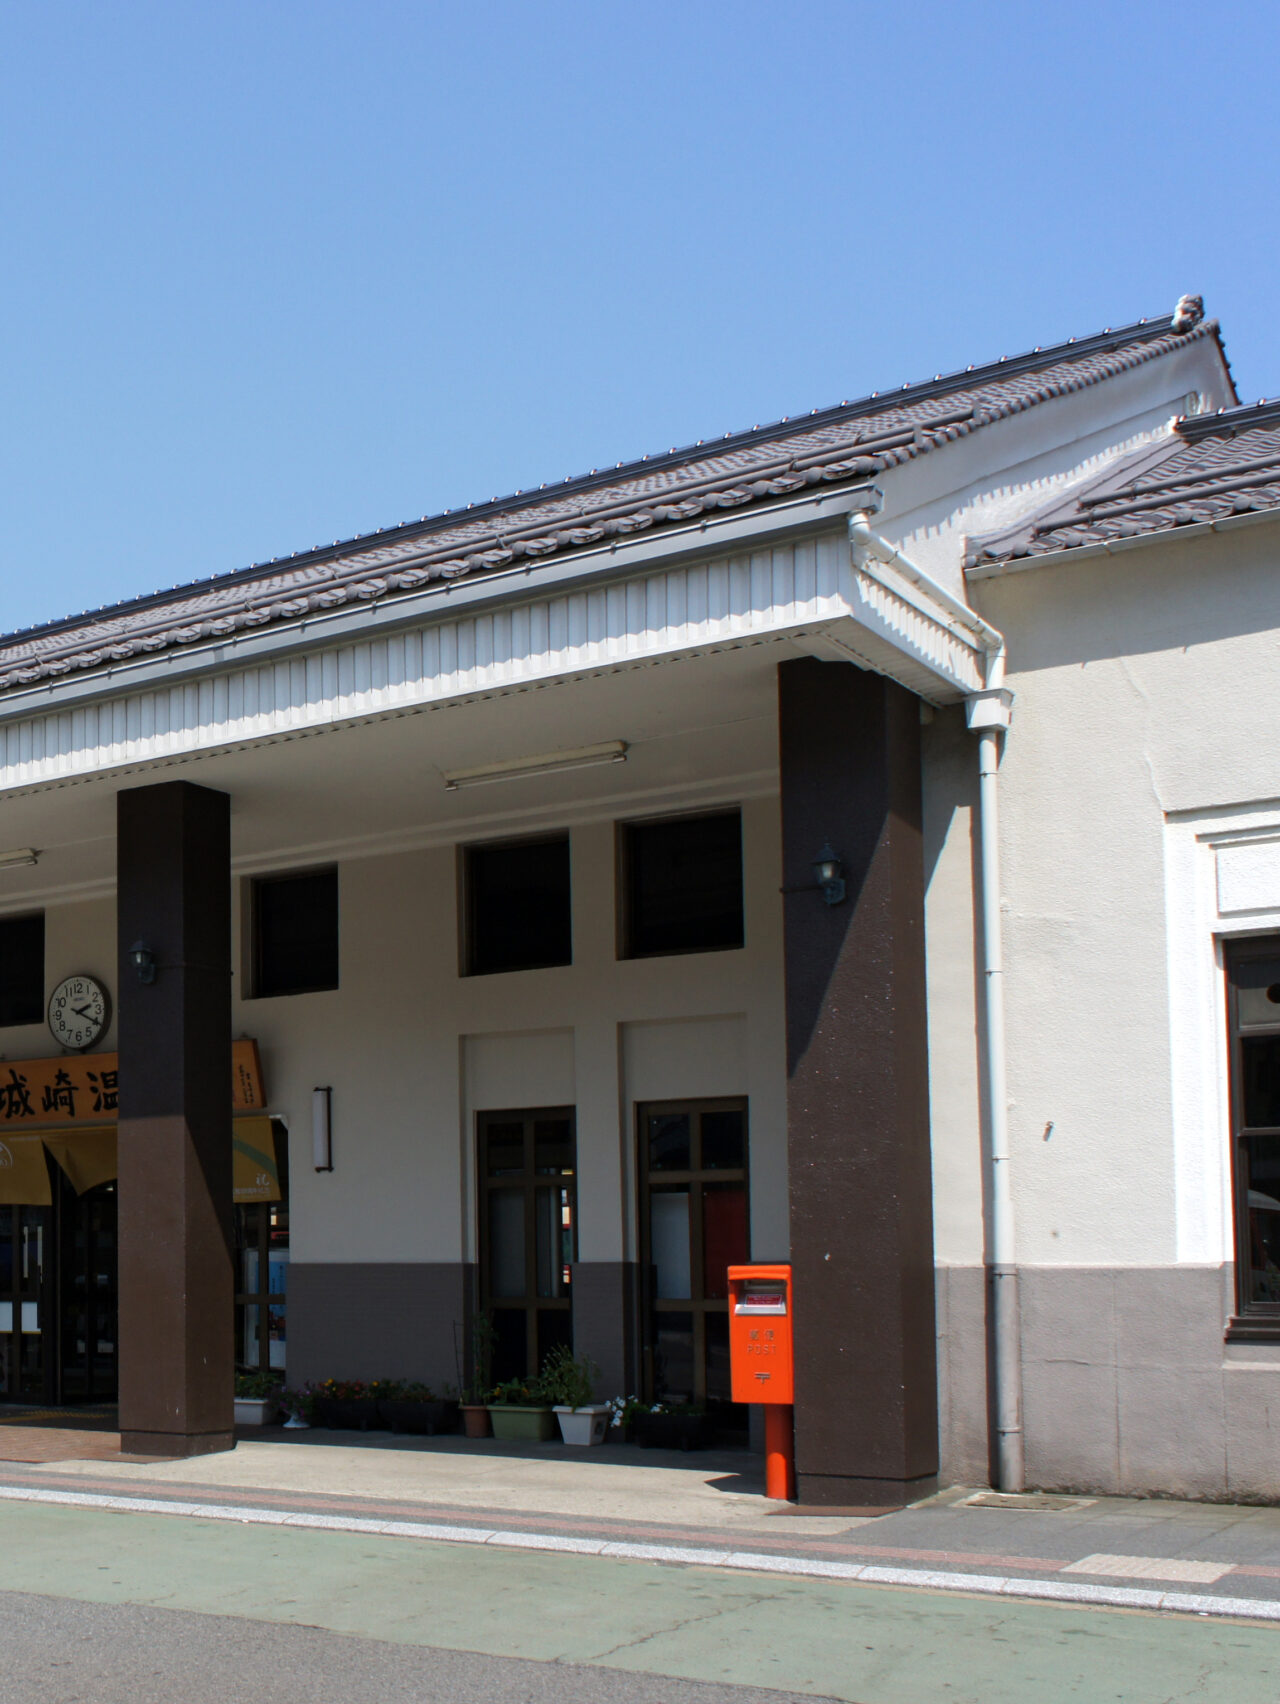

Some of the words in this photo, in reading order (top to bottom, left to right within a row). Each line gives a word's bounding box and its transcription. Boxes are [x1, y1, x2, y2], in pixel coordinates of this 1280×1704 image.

[64, 985, 73, 998] 11
[74, 983, 83, 994] 12
[55, 997, 66, 1008] 10
[92, 992, 99, 1002] 2
[55, 1010, 62, 1020] 9
[95, 1004, 102, 1015] 3
[59, 1021, 66, 1031] 8
[85, 1026, 92, 1037] 5
[66, 1029, 73, 1040] 7
[75, 1031, 82, 1042] 6
[747, 1344, 777, 1354] POST
